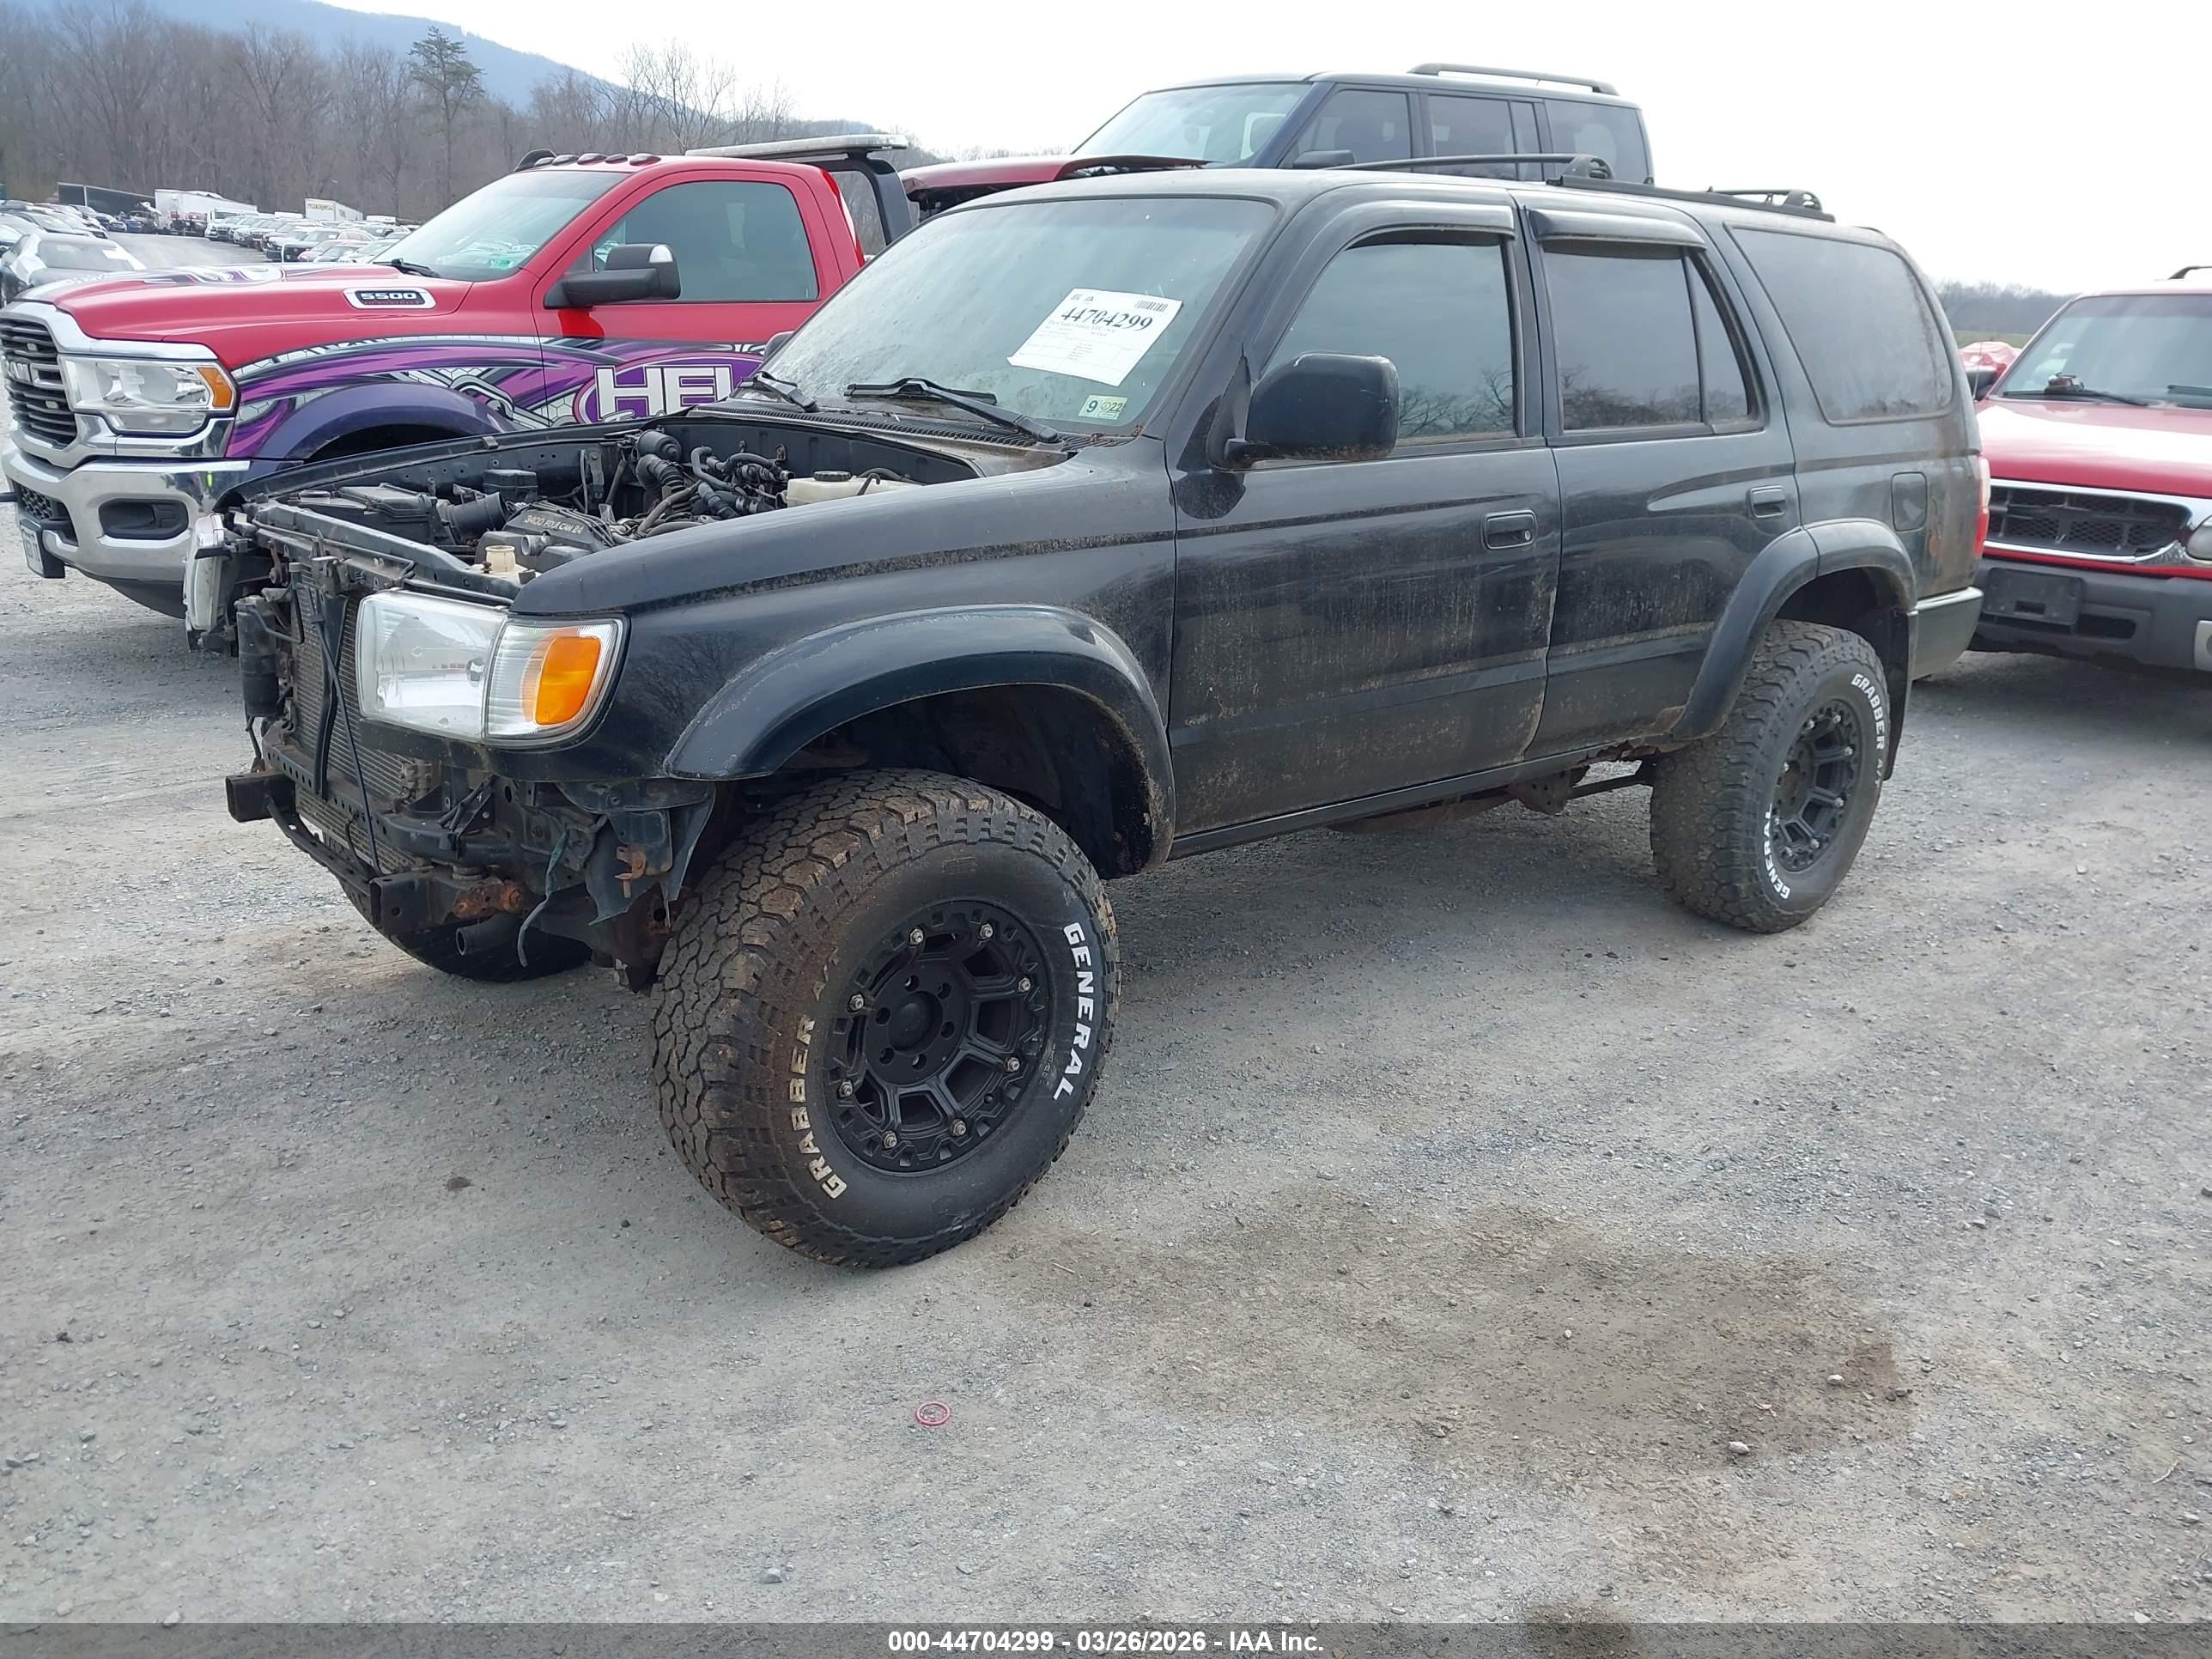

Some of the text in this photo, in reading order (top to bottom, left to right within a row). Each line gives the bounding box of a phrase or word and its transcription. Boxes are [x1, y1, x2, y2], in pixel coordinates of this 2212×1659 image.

[361, 292, 417, 301] 5500
[1060, 307, 1153, 331] 44704299
[1086, 400, 1123, 413] 9 22
[525, 515, 545, 526] 3400
[1851, 673, 1886, 750] GRABBER
[1764, 804, 1791, 900] GENERAL
[1053, 922, 1094, 1101] GENERAL
[789, 1015, 848, 1200] GRABBER
